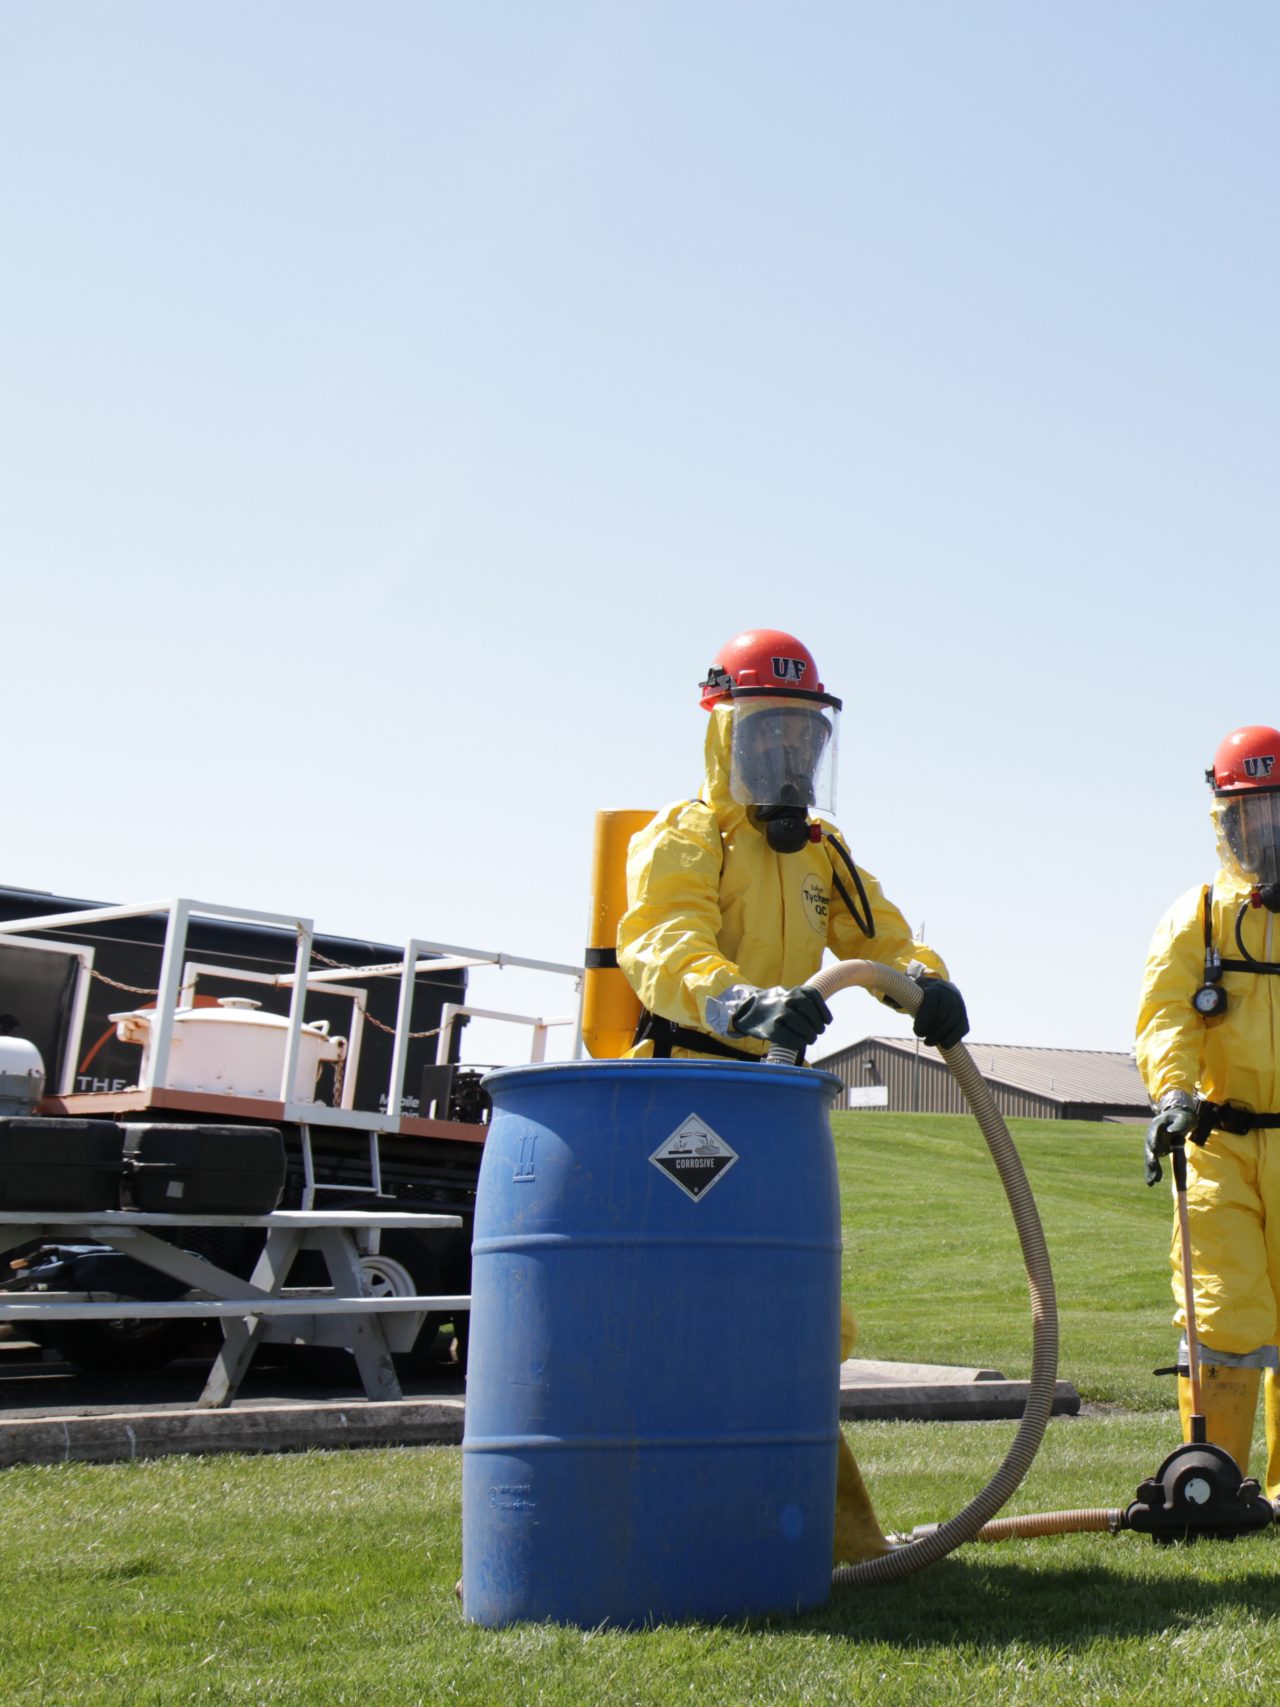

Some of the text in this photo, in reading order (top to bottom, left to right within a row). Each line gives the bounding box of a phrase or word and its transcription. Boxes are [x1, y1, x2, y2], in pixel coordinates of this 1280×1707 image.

[771, 656, 807, 681] UF
[1242, 755, 1275, 777] UF
[815, 904, 828, 917] QC
[379, 1093, 420, 1108] Mile
[675, 1158, 715, 1169] CORROSIVE
